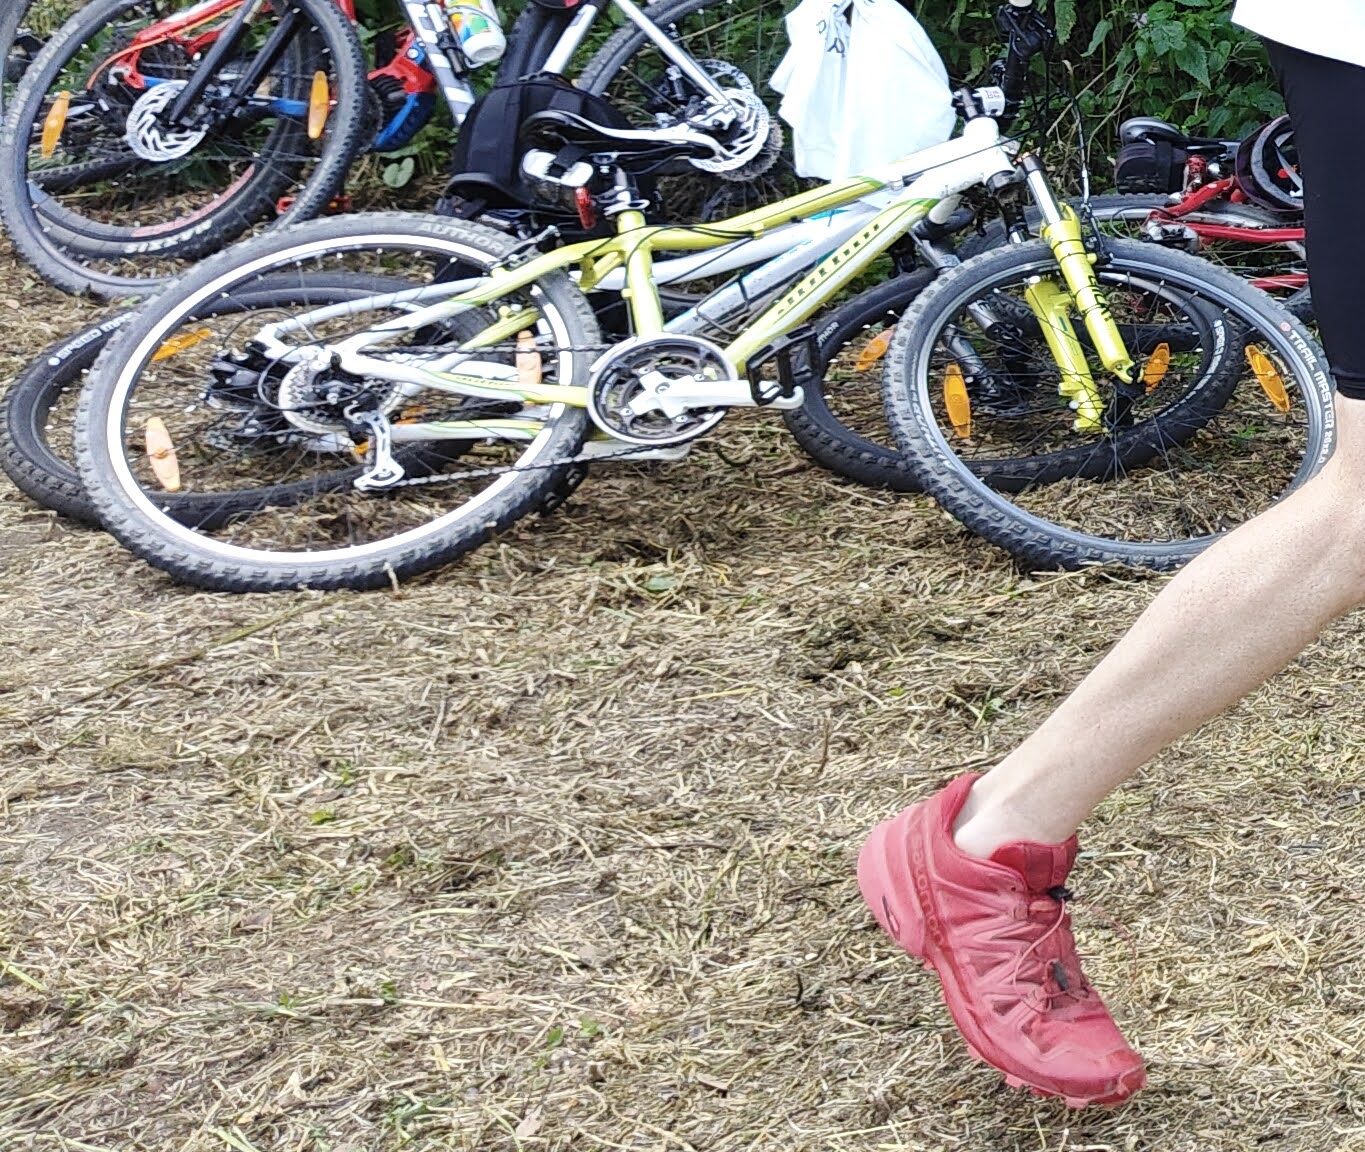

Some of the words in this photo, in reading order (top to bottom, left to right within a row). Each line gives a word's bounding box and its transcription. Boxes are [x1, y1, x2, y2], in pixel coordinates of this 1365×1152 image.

[419, 221, 505, 254] AUTHOR
[1288, 329, 1318, 371] TRAIL
[1313, 369, 1335, 431] MASTER
